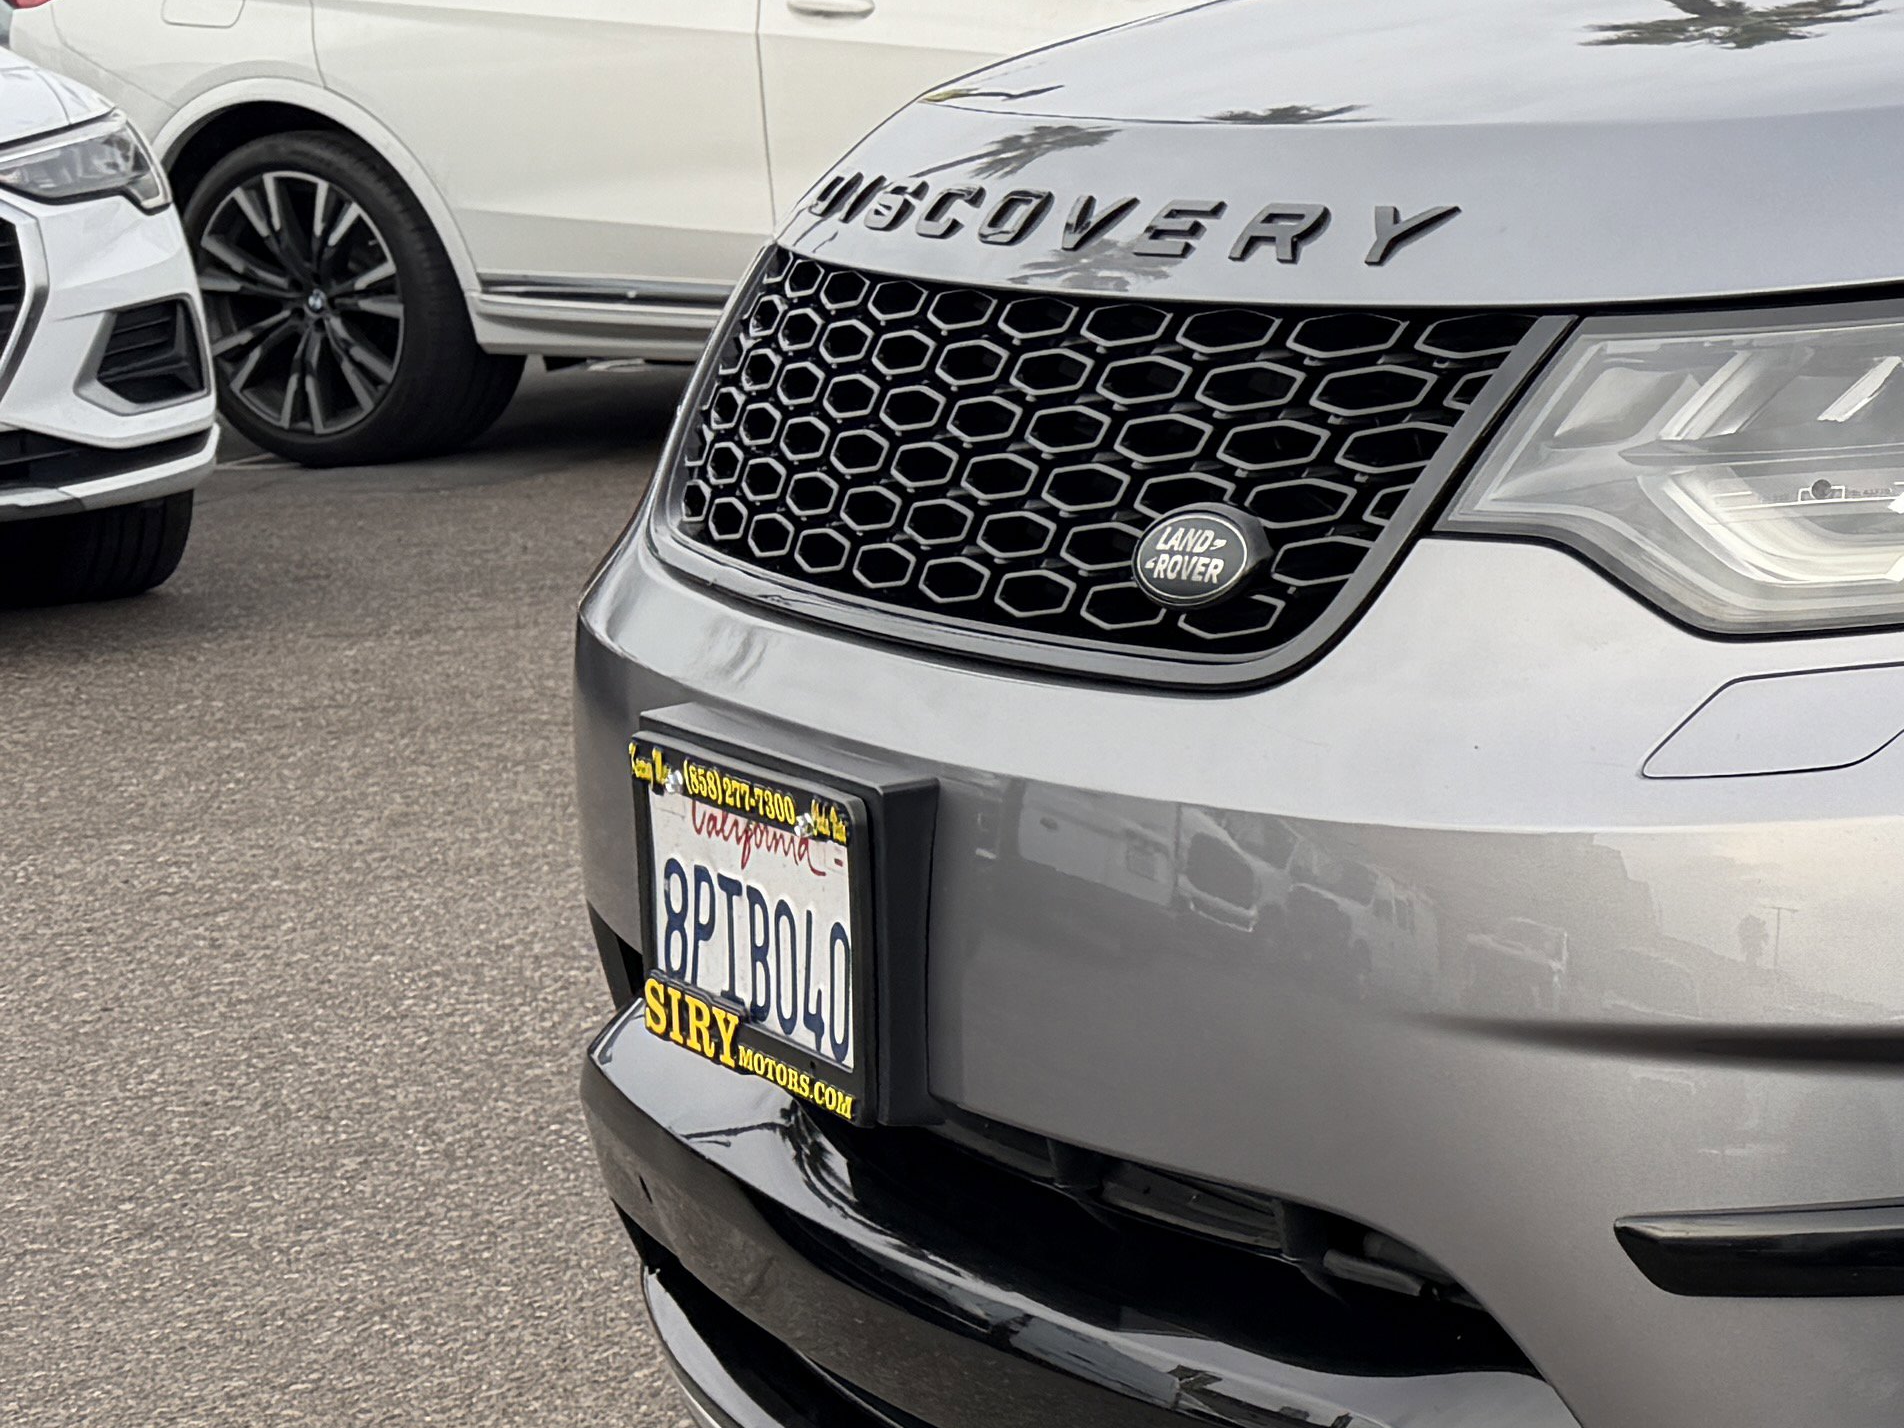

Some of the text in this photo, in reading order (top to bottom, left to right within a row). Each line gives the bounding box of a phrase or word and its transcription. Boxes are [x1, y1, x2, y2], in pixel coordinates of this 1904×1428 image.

[806, 171, 1461, 265] DISCOVERY
[1152, 556, 1224, 584] ROVER
[1155, 526, 1215, 553] LAND
[692, 798, 827, 877] California
[664, 856, 852, 1064] 8PTB040
[644, 976, 854, 1120] SIRY MOTORS.COM
